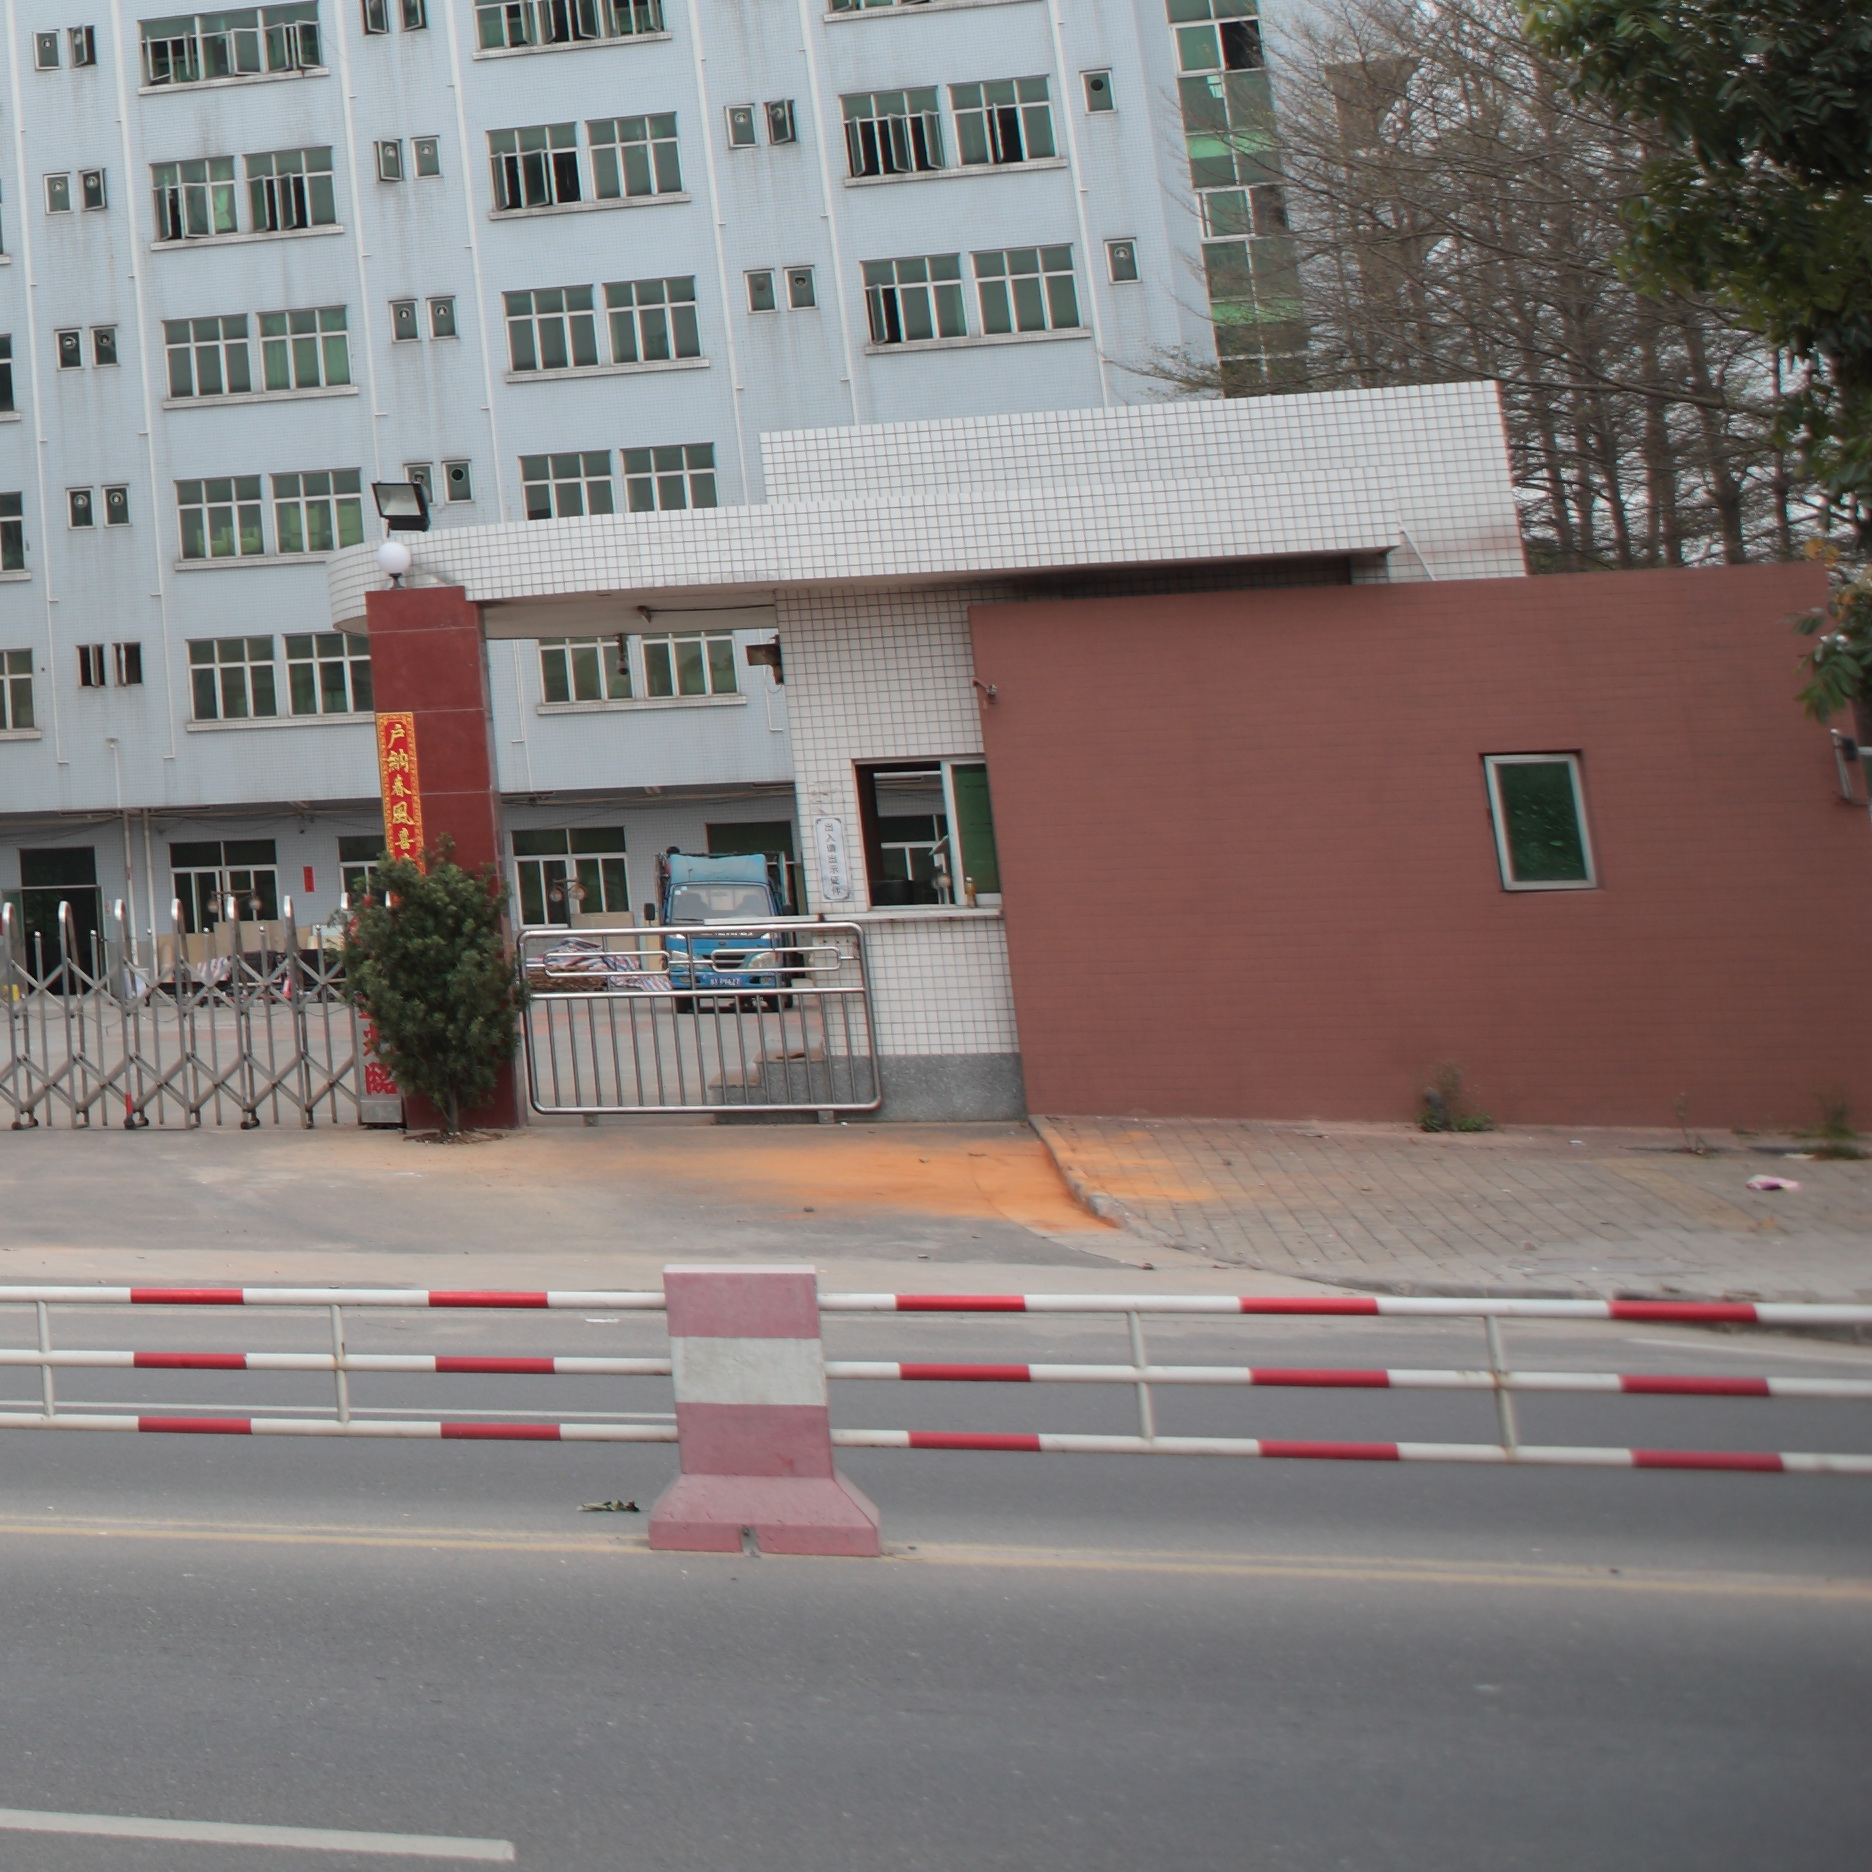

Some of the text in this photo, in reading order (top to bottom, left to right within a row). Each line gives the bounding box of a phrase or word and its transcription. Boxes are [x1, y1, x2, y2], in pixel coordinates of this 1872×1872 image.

[386, 723, 416, 858] 户納春風喜
